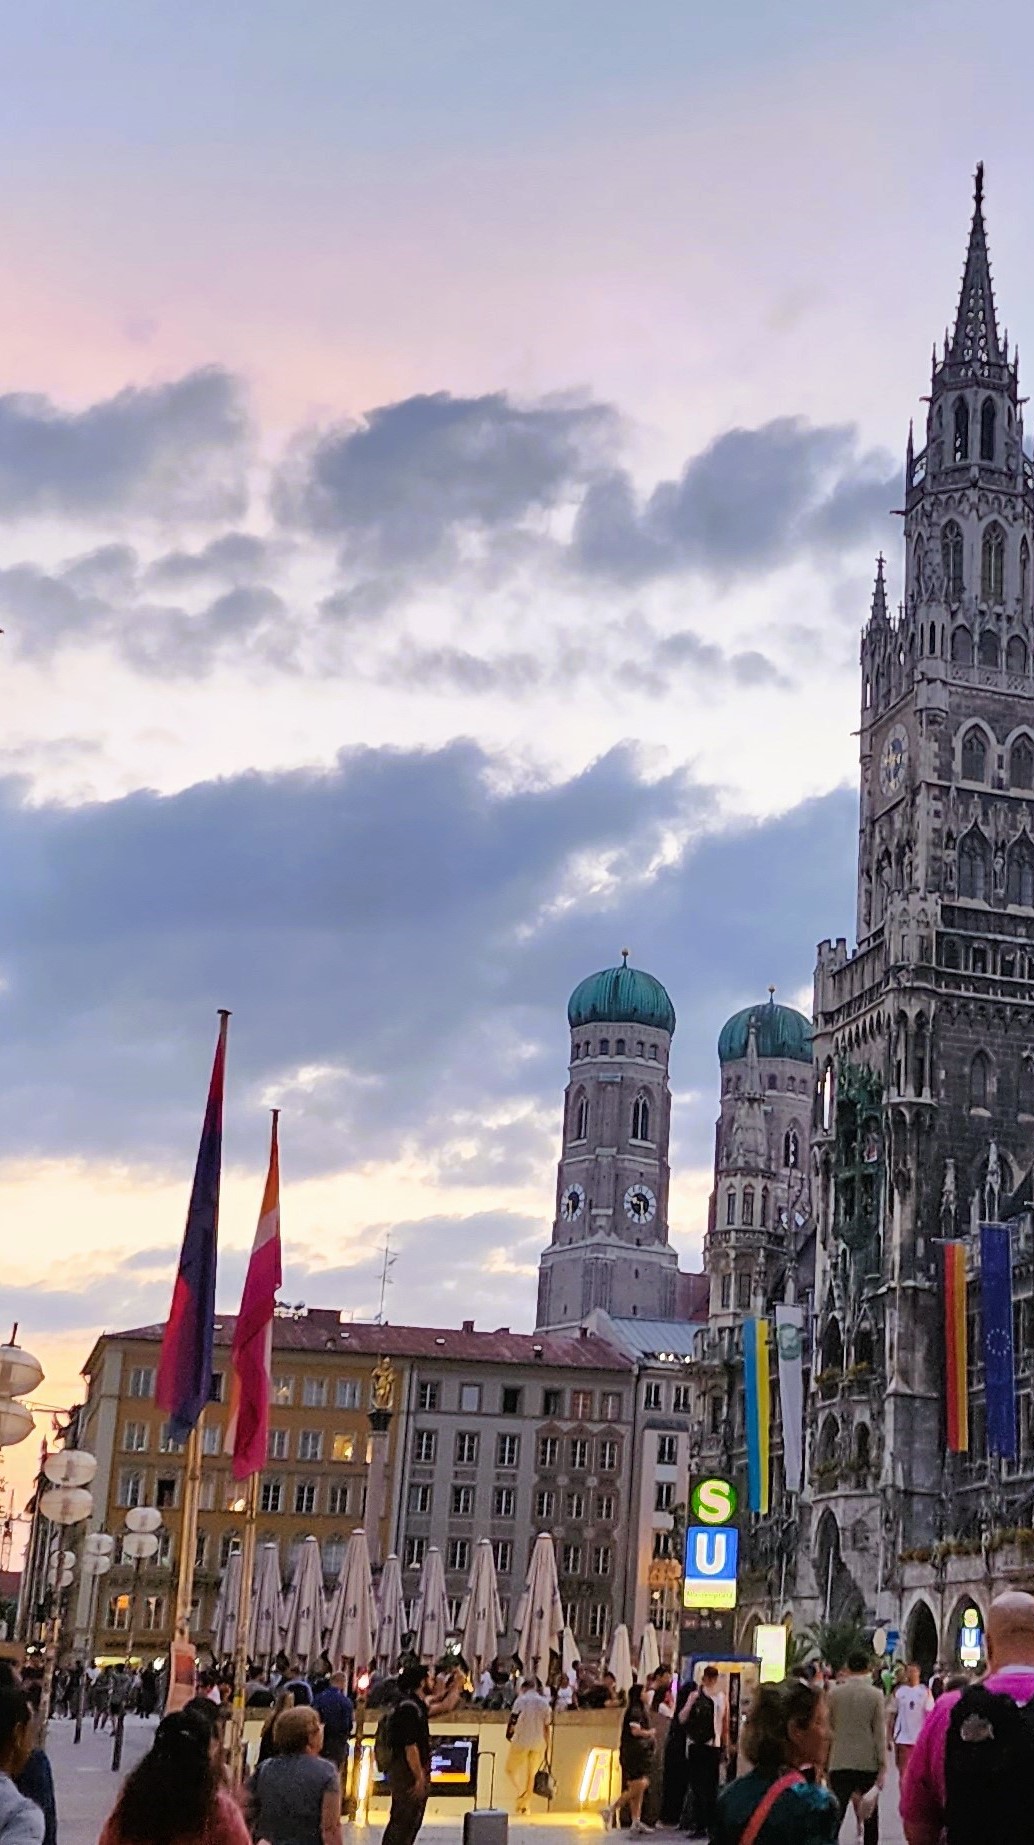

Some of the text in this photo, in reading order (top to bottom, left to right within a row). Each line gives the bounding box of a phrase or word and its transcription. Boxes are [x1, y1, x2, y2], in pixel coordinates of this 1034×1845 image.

[698, 1478, 731, 1524] S
[695, 1532, 727, 1576] U
[964, 1628, 978, 1648] U
